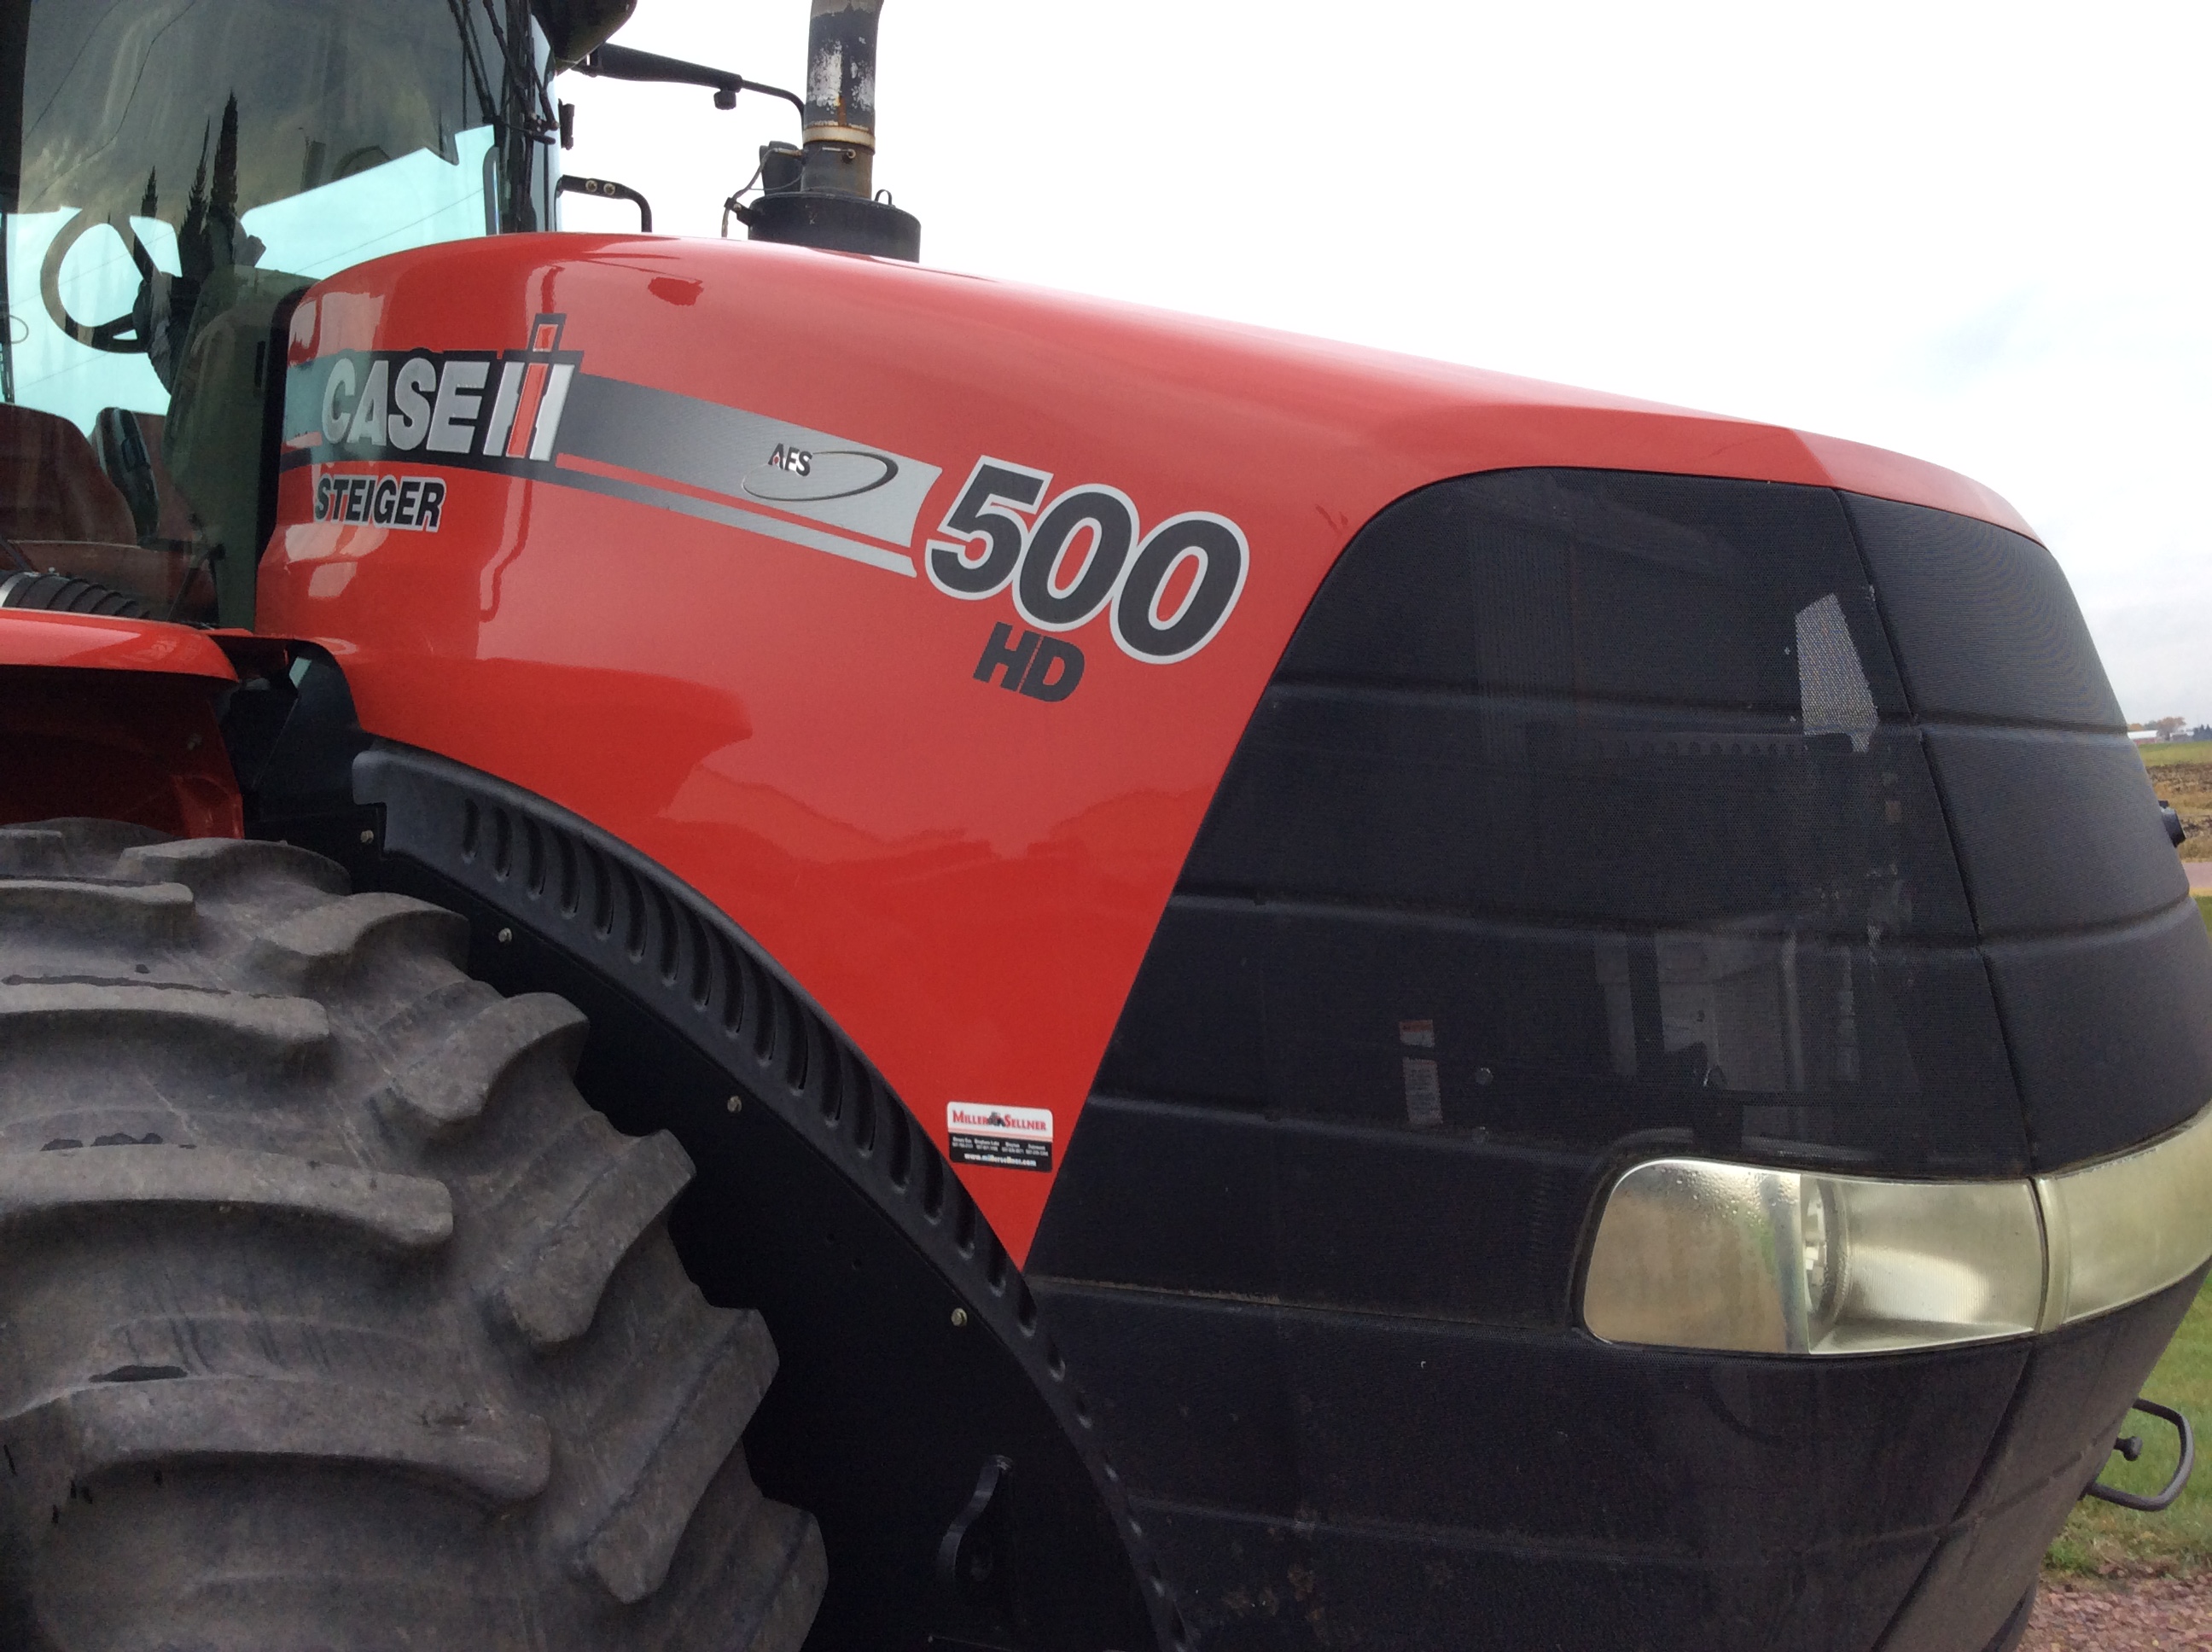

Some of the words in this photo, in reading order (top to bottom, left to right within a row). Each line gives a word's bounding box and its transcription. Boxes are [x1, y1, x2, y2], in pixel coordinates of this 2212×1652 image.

[322, 357, 491, 453] CASE
[768, 443, 813, 477] AFS
[315, 474, 446, 531] STEIGER
[925, 455, 1249, 665] 500
[973, 622, 1085, 702] HD
